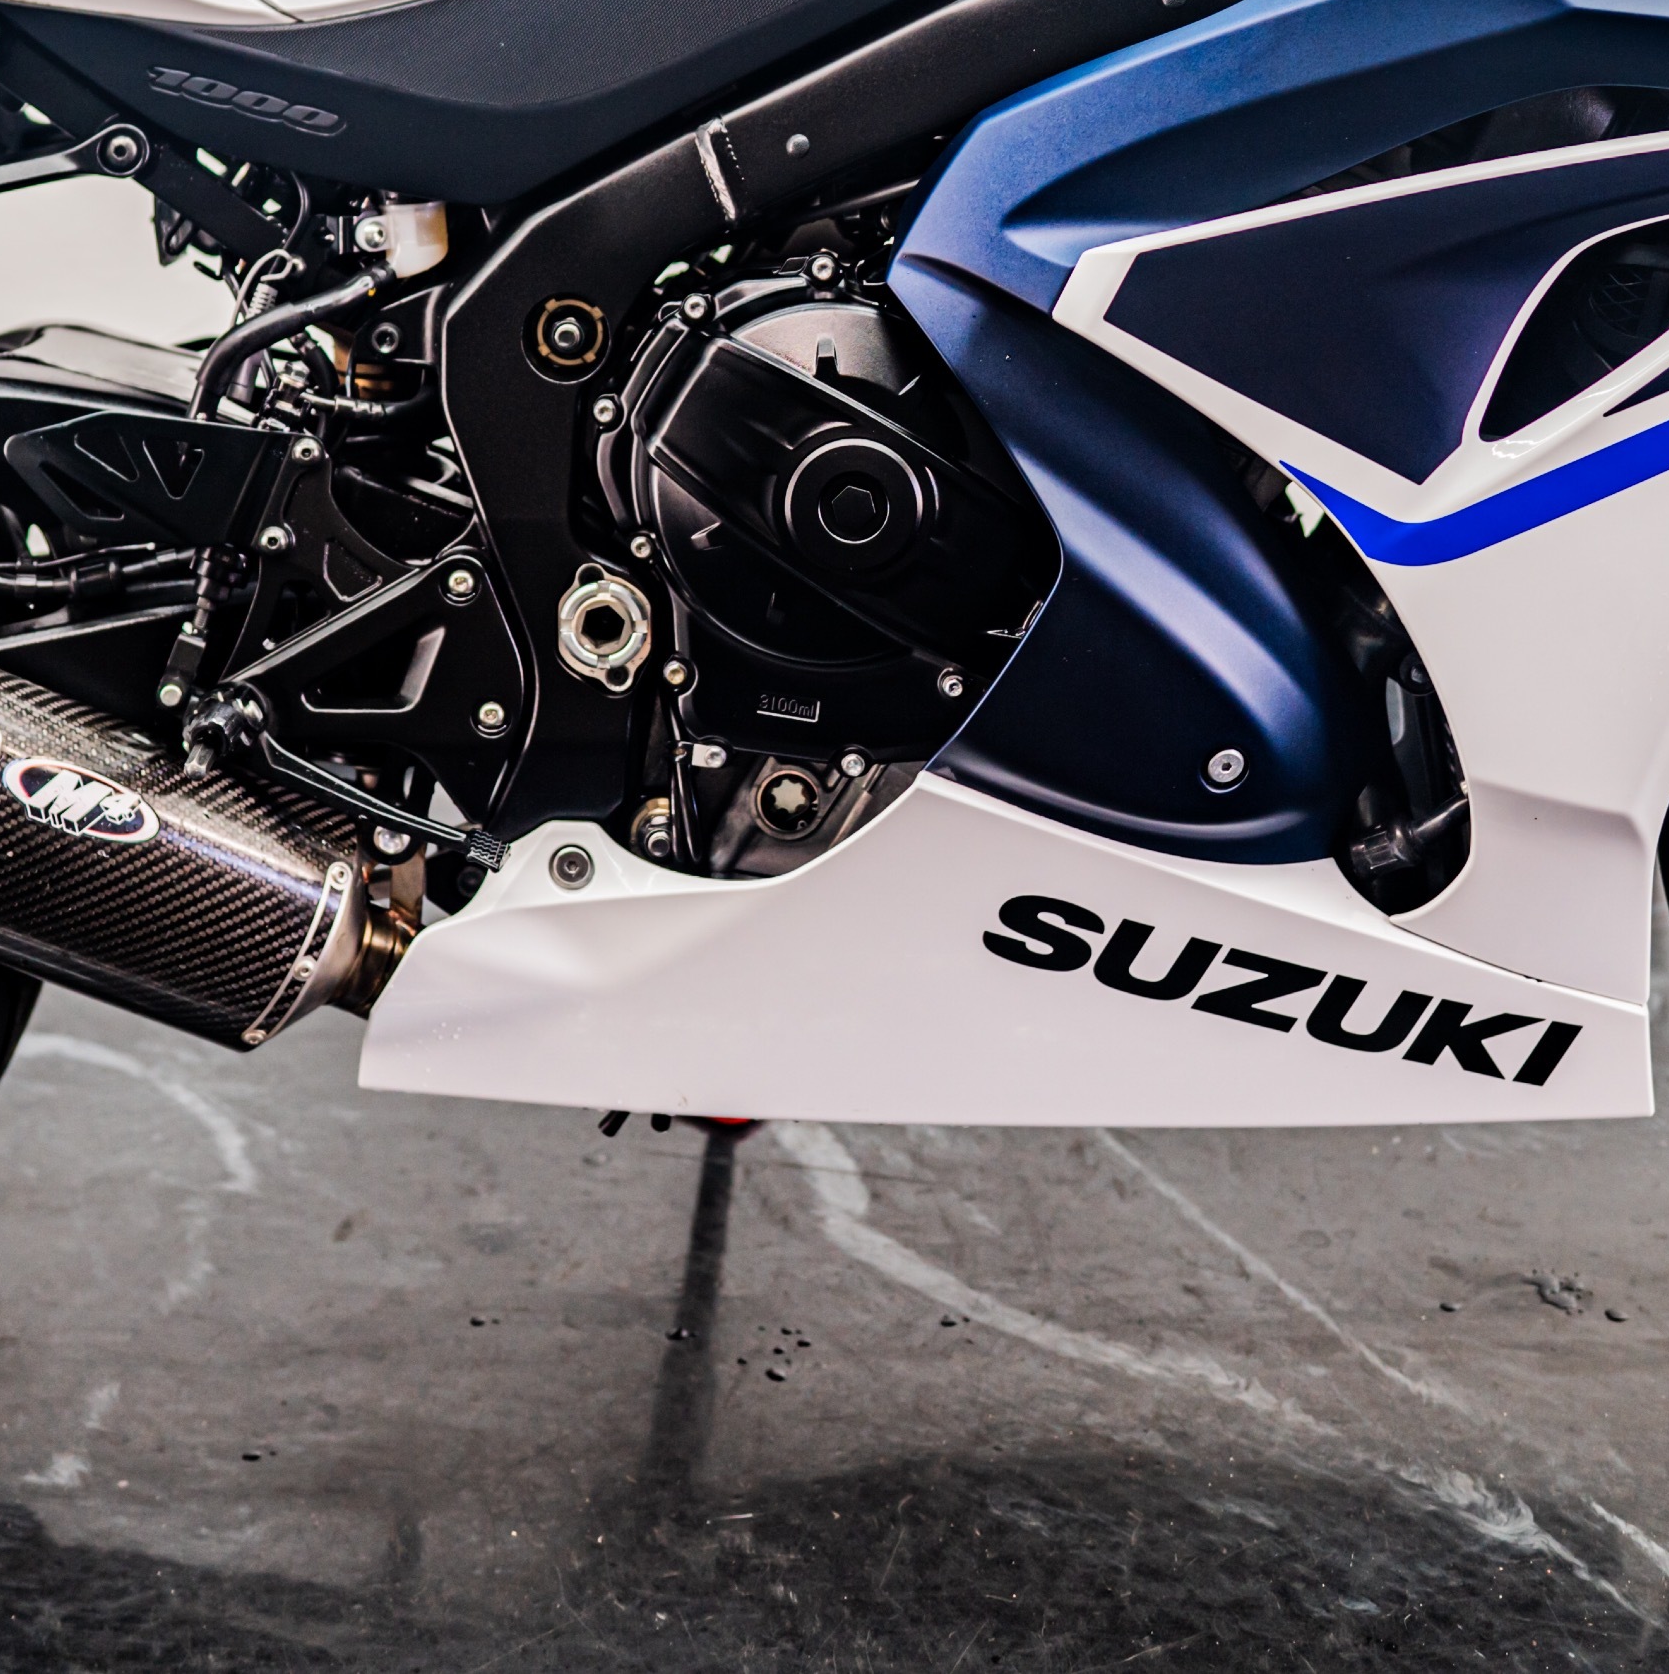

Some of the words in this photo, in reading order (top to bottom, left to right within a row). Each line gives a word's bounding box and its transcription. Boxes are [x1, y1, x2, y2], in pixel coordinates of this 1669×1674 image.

[147, 66, 347, 137] 1000
[25, 769, 141, 836] M4
[982, 894, 1583, 1087] SUZUKI
